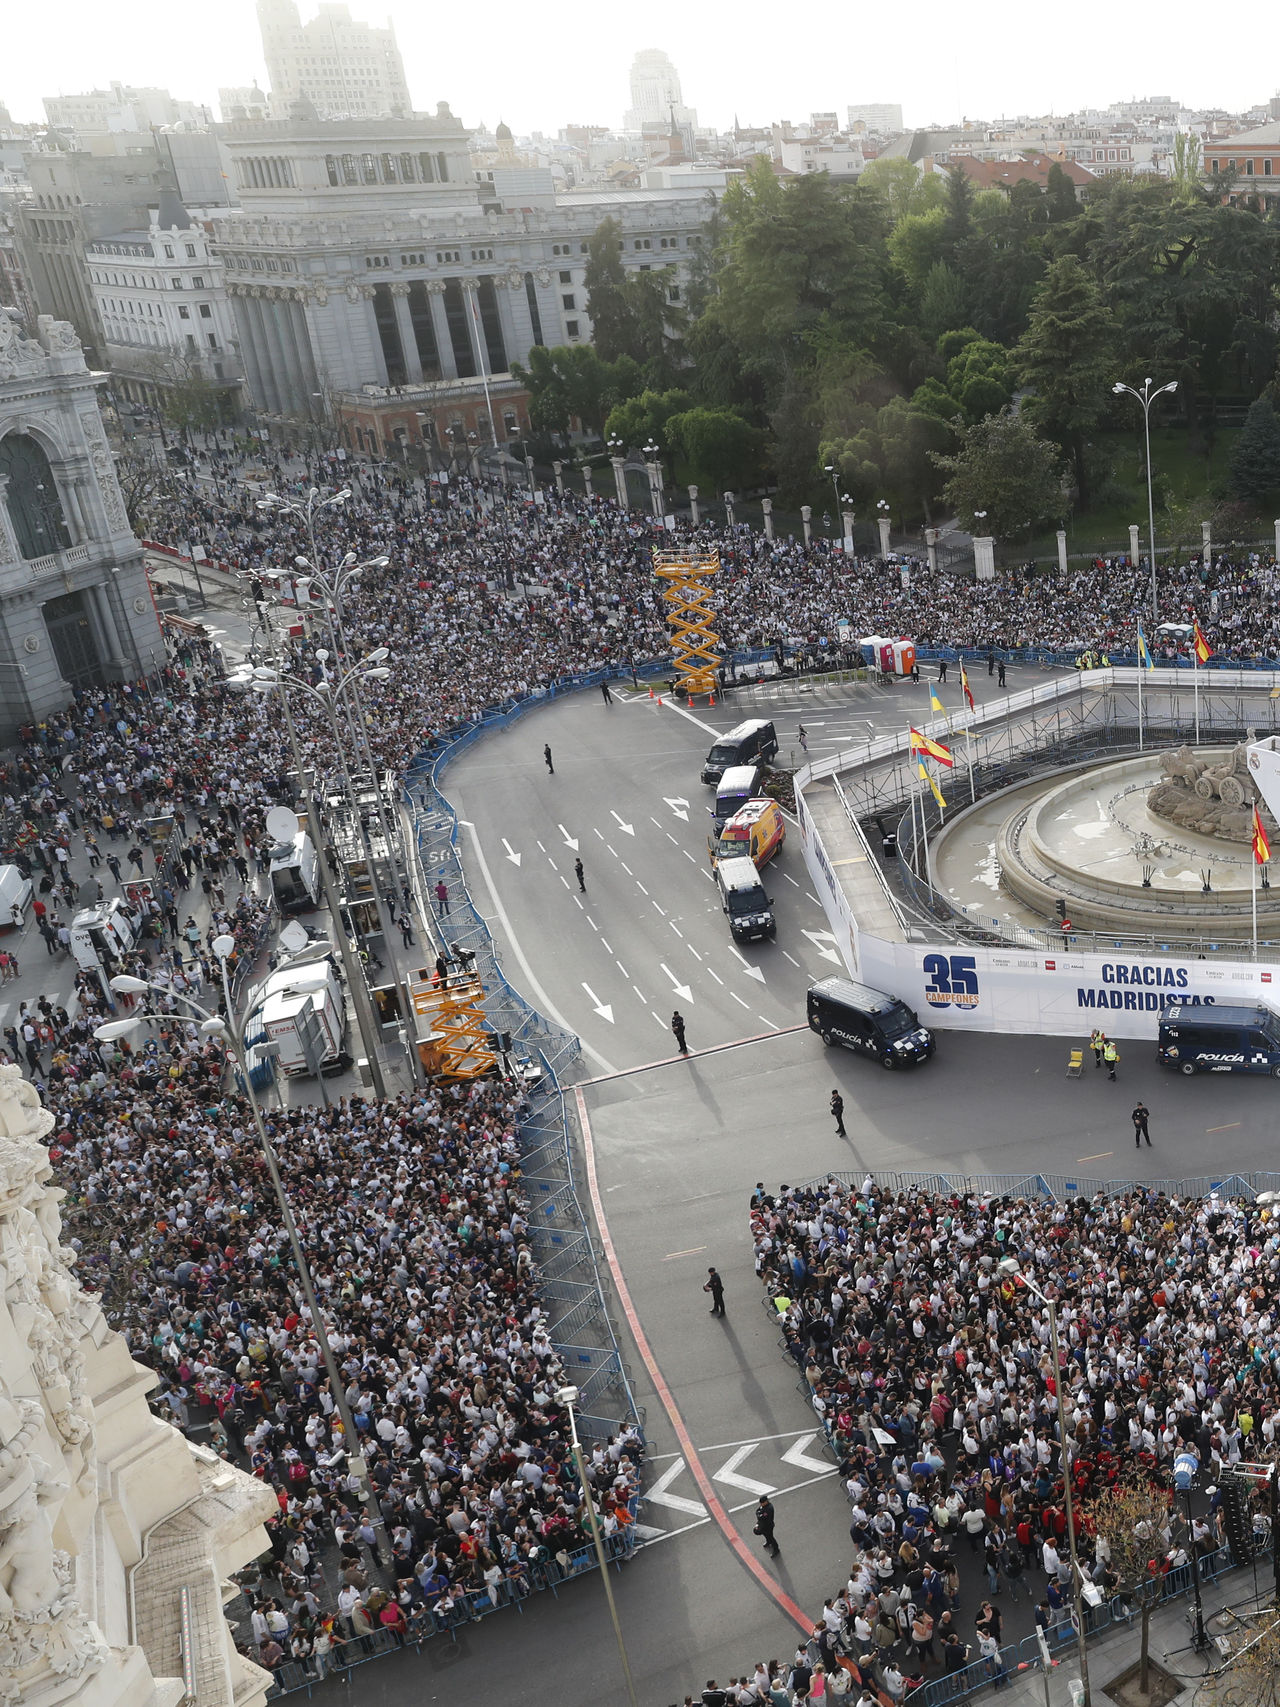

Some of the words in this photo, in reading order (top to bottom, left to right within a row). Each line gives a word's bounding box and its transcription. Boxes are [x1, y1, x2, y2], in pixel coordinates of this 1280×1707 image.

[923, 953, 979, 1010] 35
[1101, 963, 1188, 988] GRACIAS
[925, 992, 980, 1005] CAMPEONES
[831, 1027, 862, 1045] POLICÍA
[1195, 1052, 1245, 1063] POLICÍA
